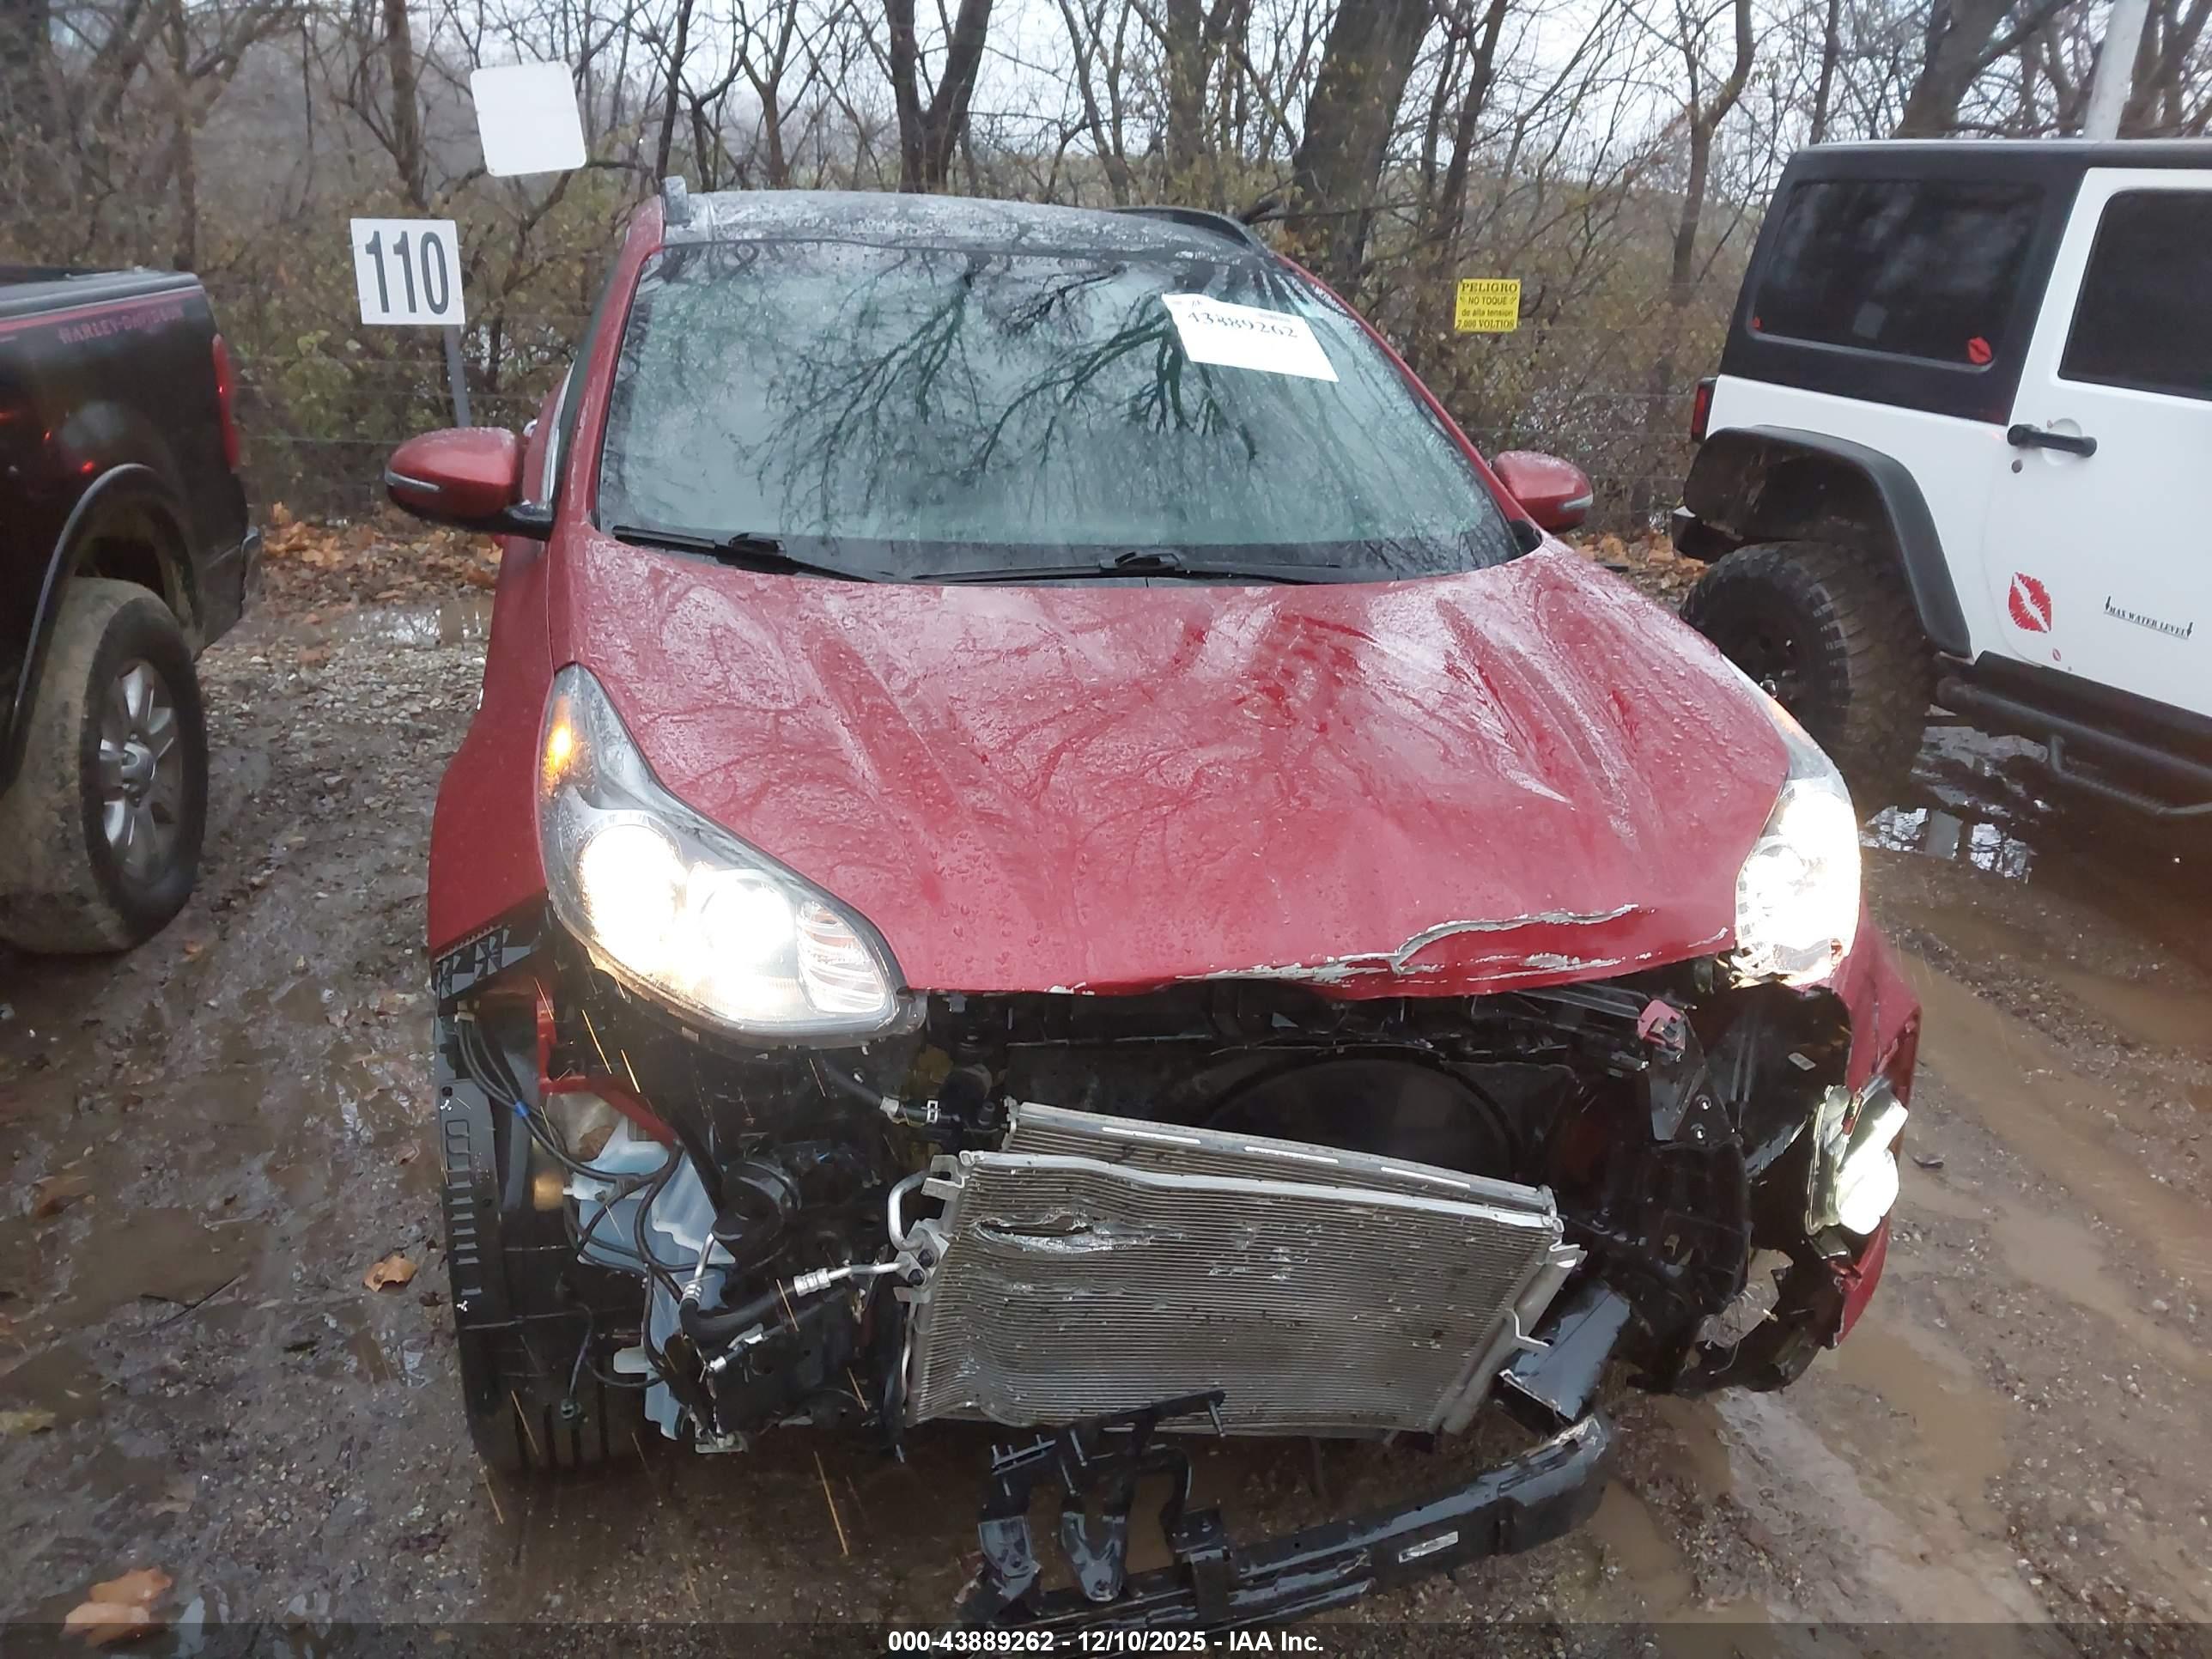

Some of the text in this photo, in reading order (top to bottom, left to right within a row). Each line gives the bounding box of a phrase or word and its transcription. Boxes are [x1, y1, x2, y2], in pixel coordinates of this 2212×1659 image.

[365, 231, 449, 315] 110
[1462, 283, 1517, 293] PELIGRO
[1468, 296, 1507, 305] NO TOQUE
[1479, 319, 1515, 328] VOLTIOS
[2110, 605, 2185, 636] MAX WATER LEVEL
